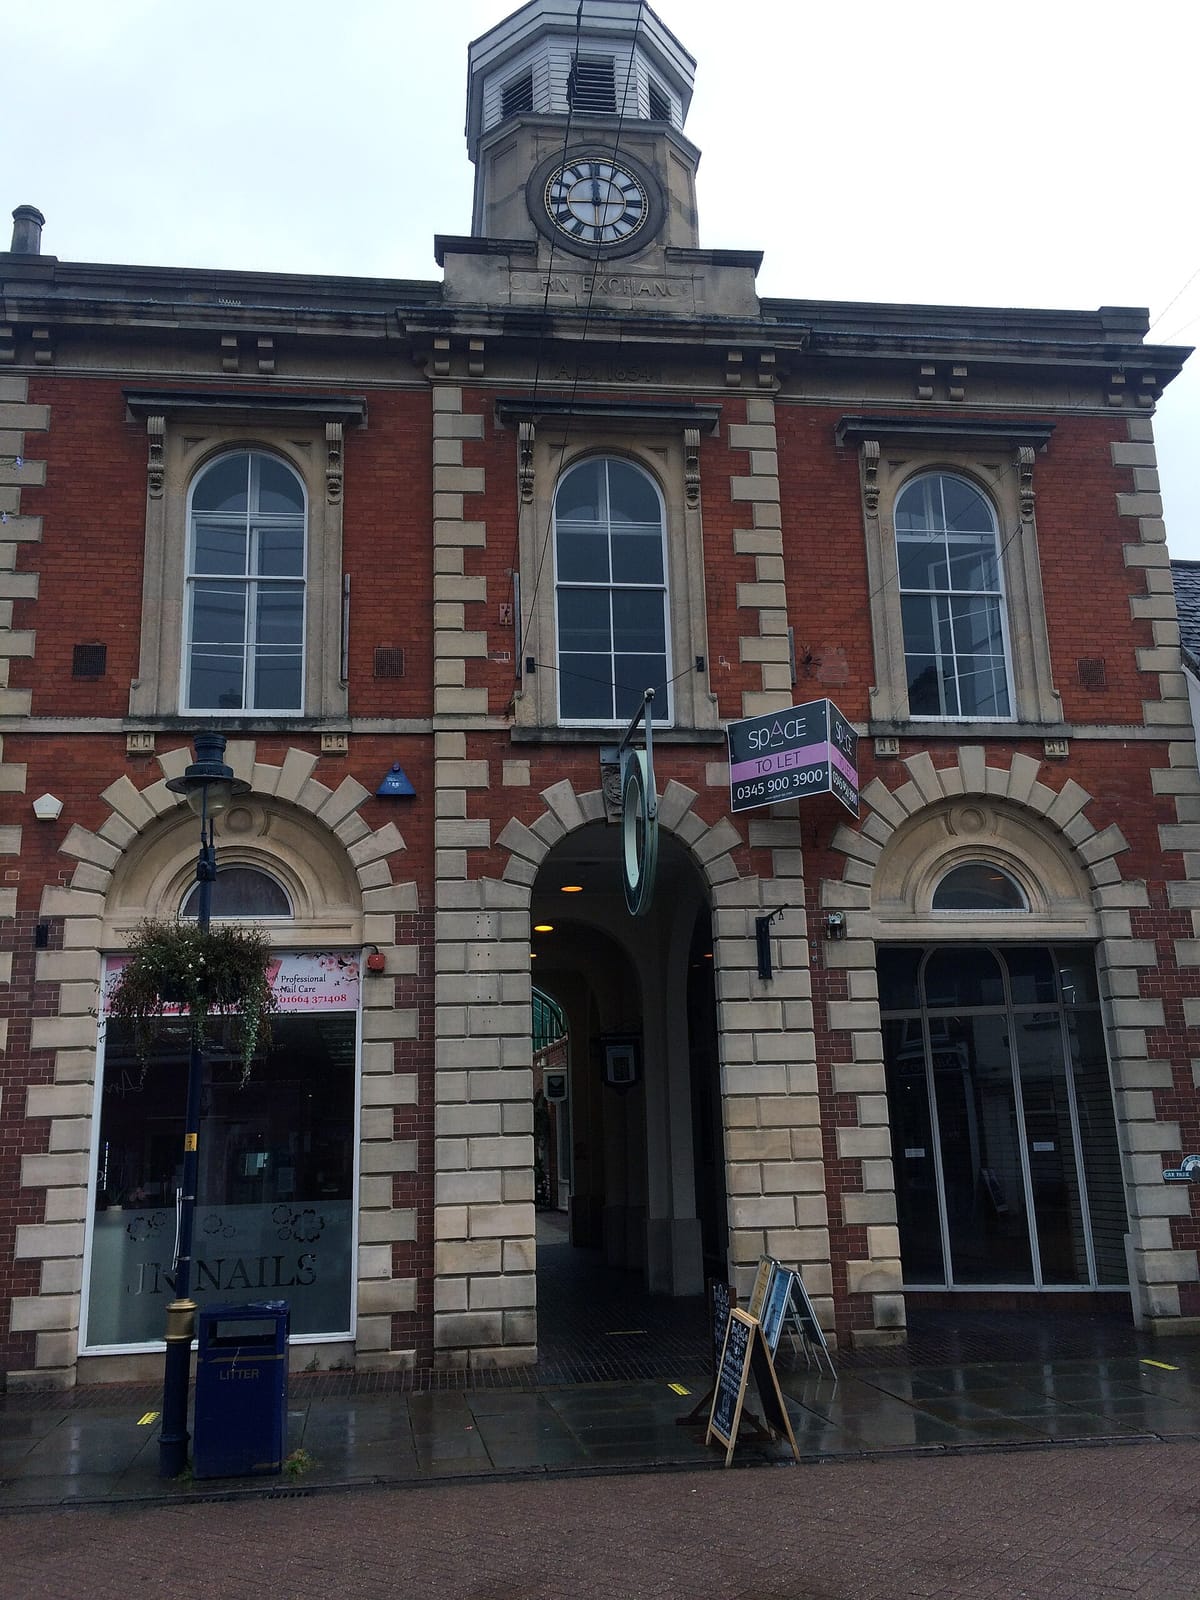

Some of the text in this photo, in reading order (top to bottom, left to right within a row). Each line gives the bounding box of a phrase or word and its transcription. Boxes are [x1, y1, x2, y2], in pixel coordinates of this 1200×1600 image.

[756, 751, 800, 774] TO LET
[737, 782, 764, 800] 0345
[768, 777, 789, 793] 900
[793, 769, 822, 787] 3900
[281, 974, 326, 985] Professional
[281, 985, 316, 994] Nail Care
[280, 994, 347, 1004] 01664 371408
[193, 1253, 317, 1292] NAILS
[219, 1368, 260, 1380] LITTER
